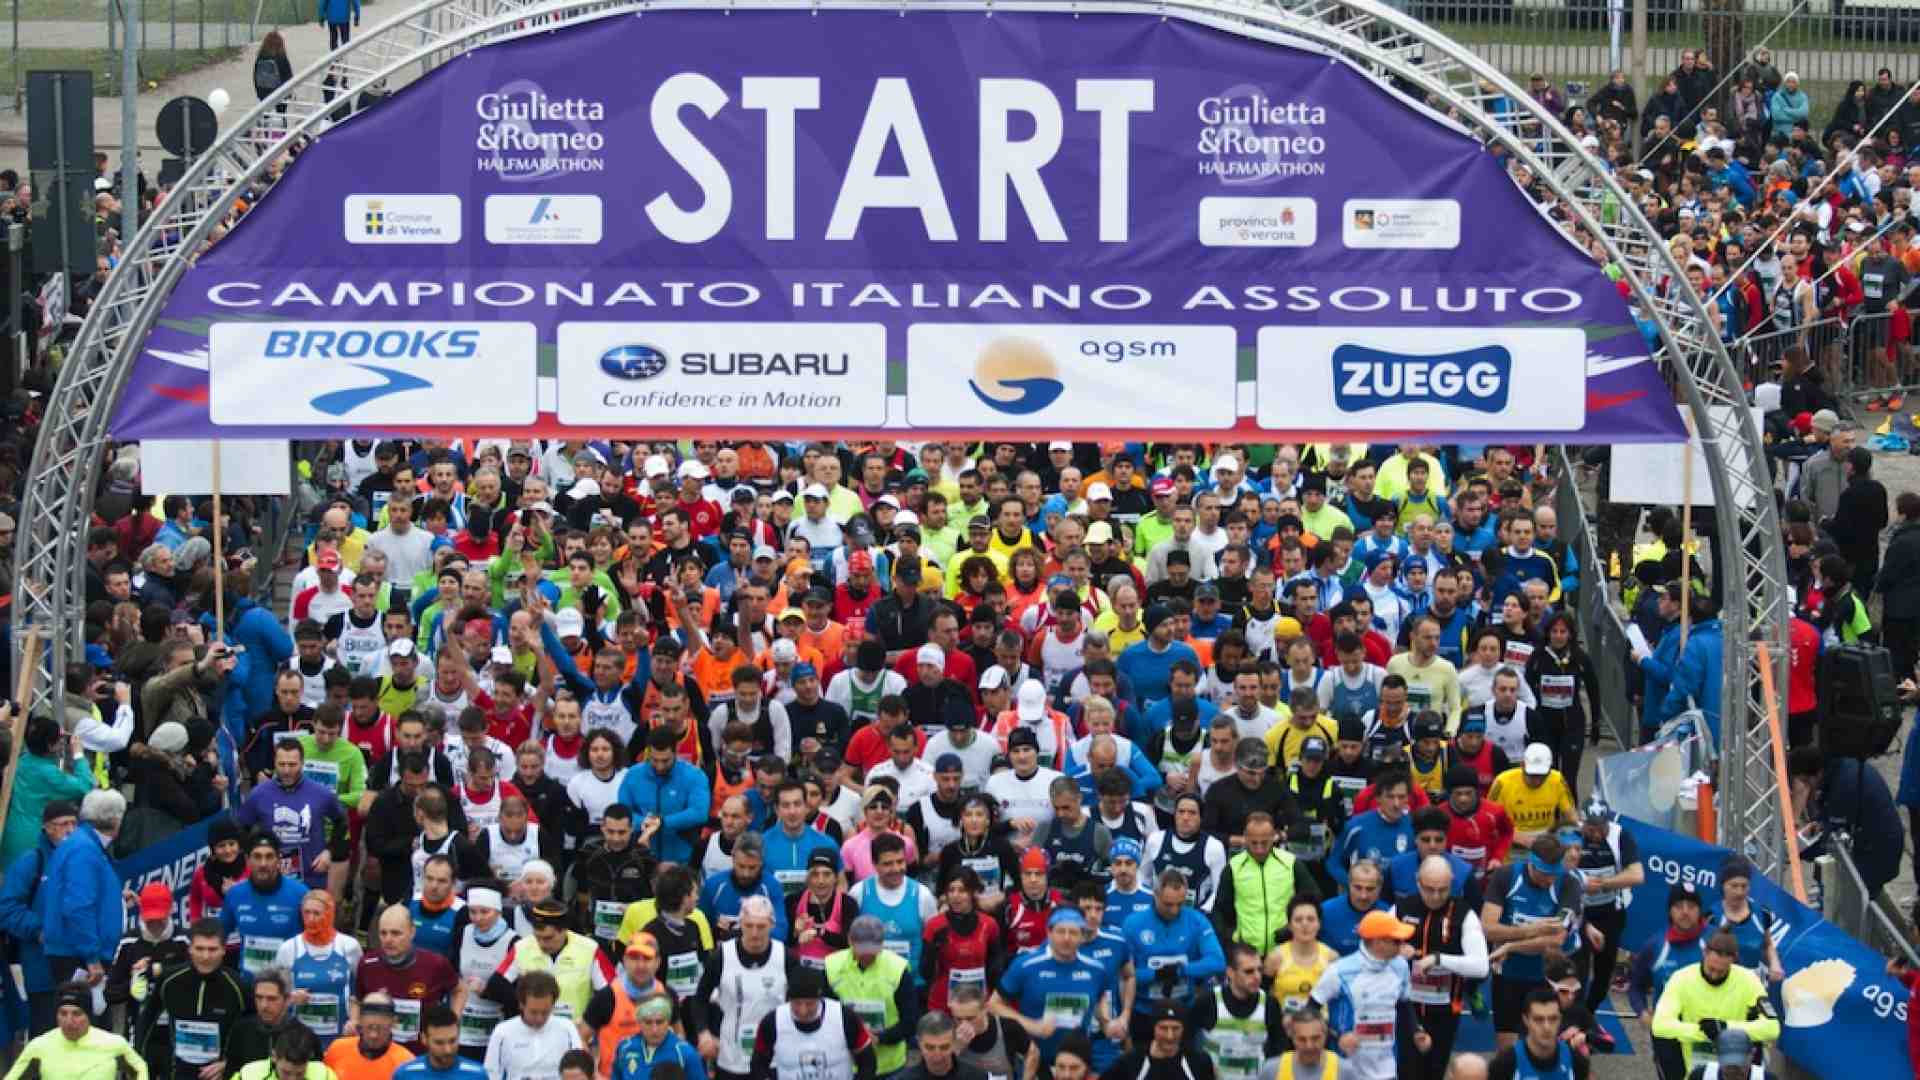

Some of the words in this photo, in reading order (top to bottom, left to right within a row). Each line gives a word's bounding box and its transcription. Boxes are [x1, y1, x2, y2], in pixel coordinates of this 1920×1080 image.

[477, 91, 603, 120] Giulietta
[1198, 95, 1325, 125] Giulietta
[477, 123, 603, 151] &Romeo
[1198, 127, 1325, 155] &Romeo
[645, 73, 1154, 243] START
[386, 211, 433, 223] Comune
[386, 224, 398, 236] di
[400, 224, 442, 237] Verona
[1218, 215, 1280, 229] provincia
[1250, 230, 1296, 241] verona
[207, 281, 761, 307] CAMPIONATO
[793, 282, 1152, 309] ITALIANO
[1183, 286, 1583, 312] ASSOLUTO
[263, 329, 480, 359] BROOKS
[1080, 340, 1177, 363] agsm
[681, 353, 849, 376] SUBARU
[1342, 362, 1501, 397] ZUEGG
[602, 391, 732, 408] Confidence
[738, 391, 757, 408] in
[763, 391, 841, 408] Motion
[1648, 855, 1716, 888] agsm
[1862, 984, 1908, 1021] ags
